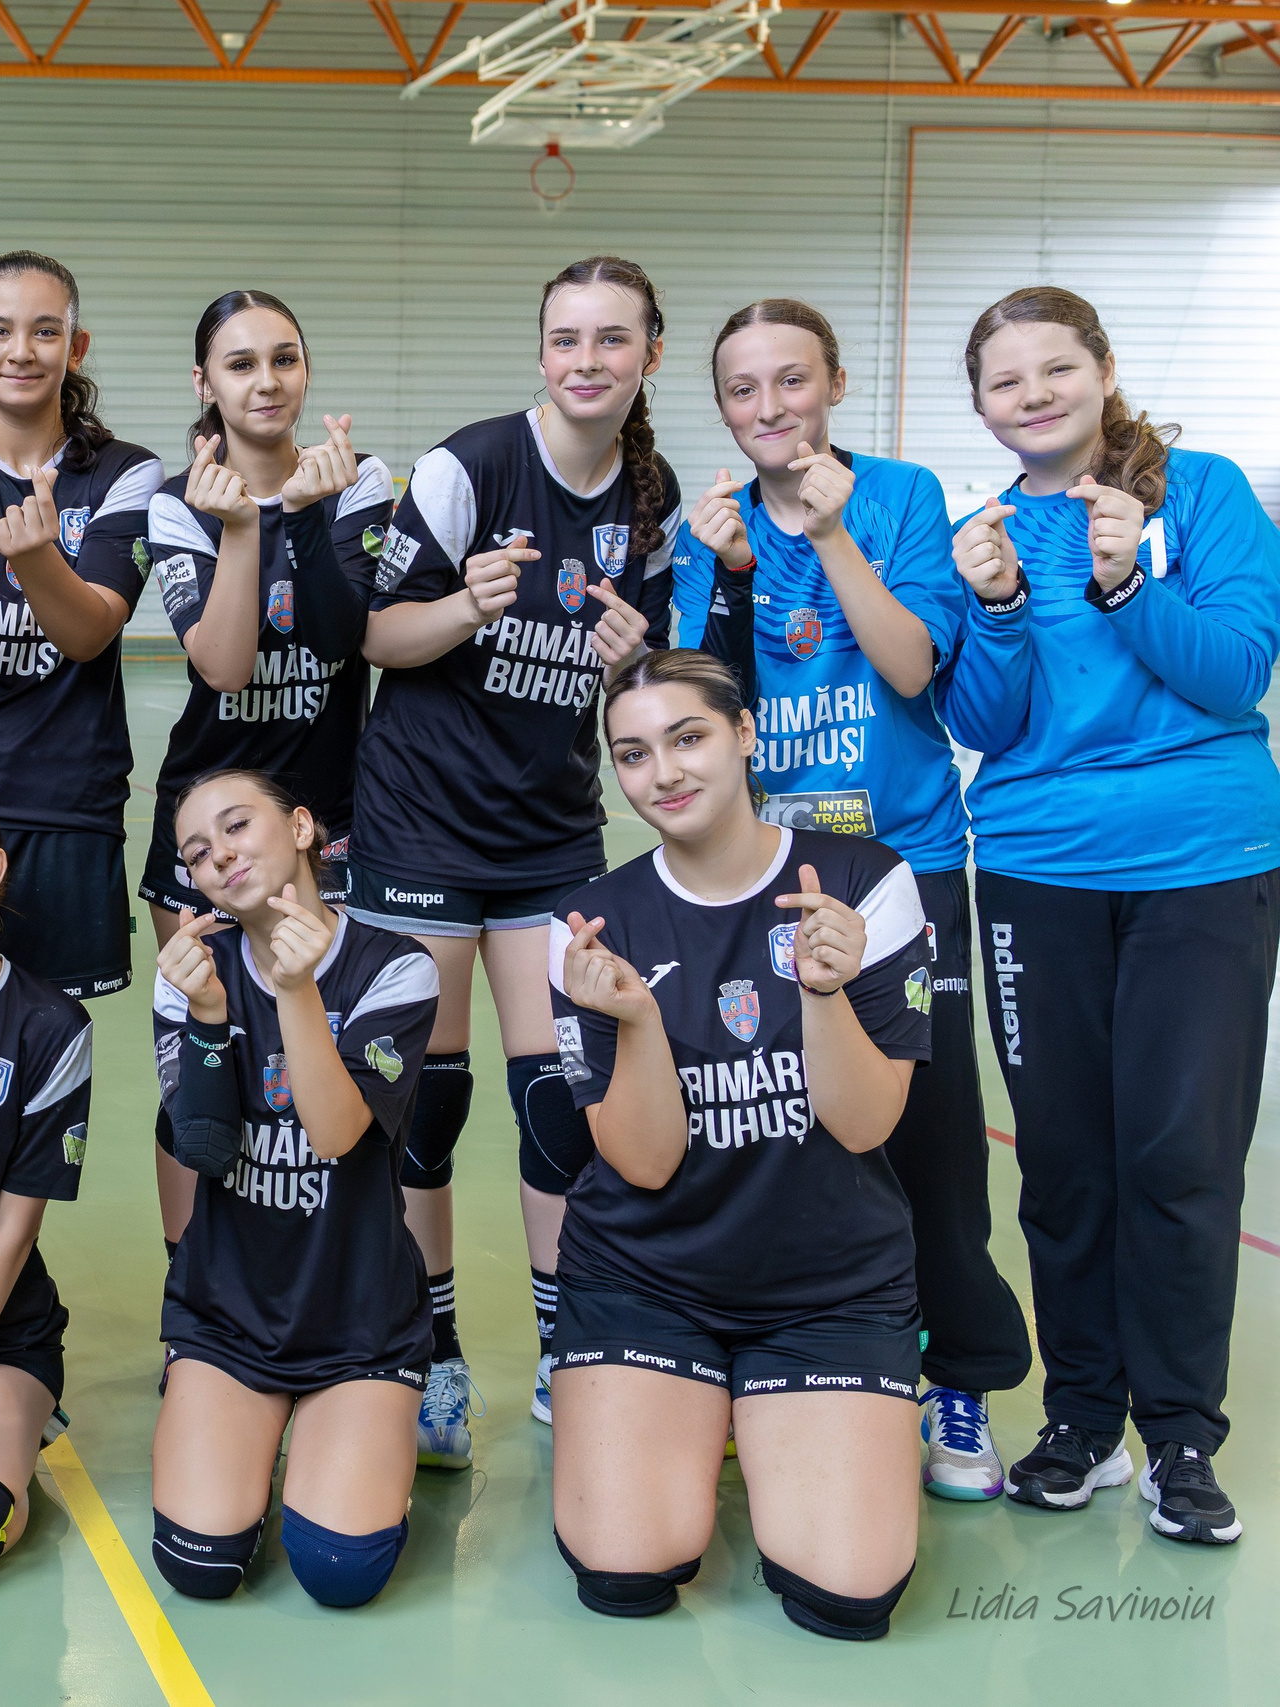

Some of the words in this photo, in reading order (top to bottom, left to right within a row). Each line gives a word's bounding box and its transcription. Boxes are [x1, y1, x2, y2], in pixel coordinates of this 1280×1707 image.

[1139, 517, 1168, 579] 1
[166, 560, 185, 573] Tya
[1105, 570, 1146, 608] Kempa
[985, 590, 1027, 613] Kempa
[219, 683, 330, 726] BUHUȘI
[755, 681, 877, 734] RIMĂRIA
[751, 726, 866, 773] BUHUȘI
[818, 799, 864, 812] INTER
[812, 811, 865, 824] TRANS
[831, 822, 867, 834] COM
[385, 887, 444, 908] Kempa
[775, 933, 794, 947] CS
[93, 978, 123, 992] Kempa
[991, 923, 1024, 1066] Kempa
[222, 1158, 330, 1217] UHUȘI
[565, 1351, 604, 1364] Kempa
[624, 1349, 676, 1369] Kempa
[691, 1361, 727, 1382] Kempa
[744, 1377, 787, 1392] Kempa
[805, 1374, 863, 1388] Kempa
[879, 1376, 913, 1395] Kempa
